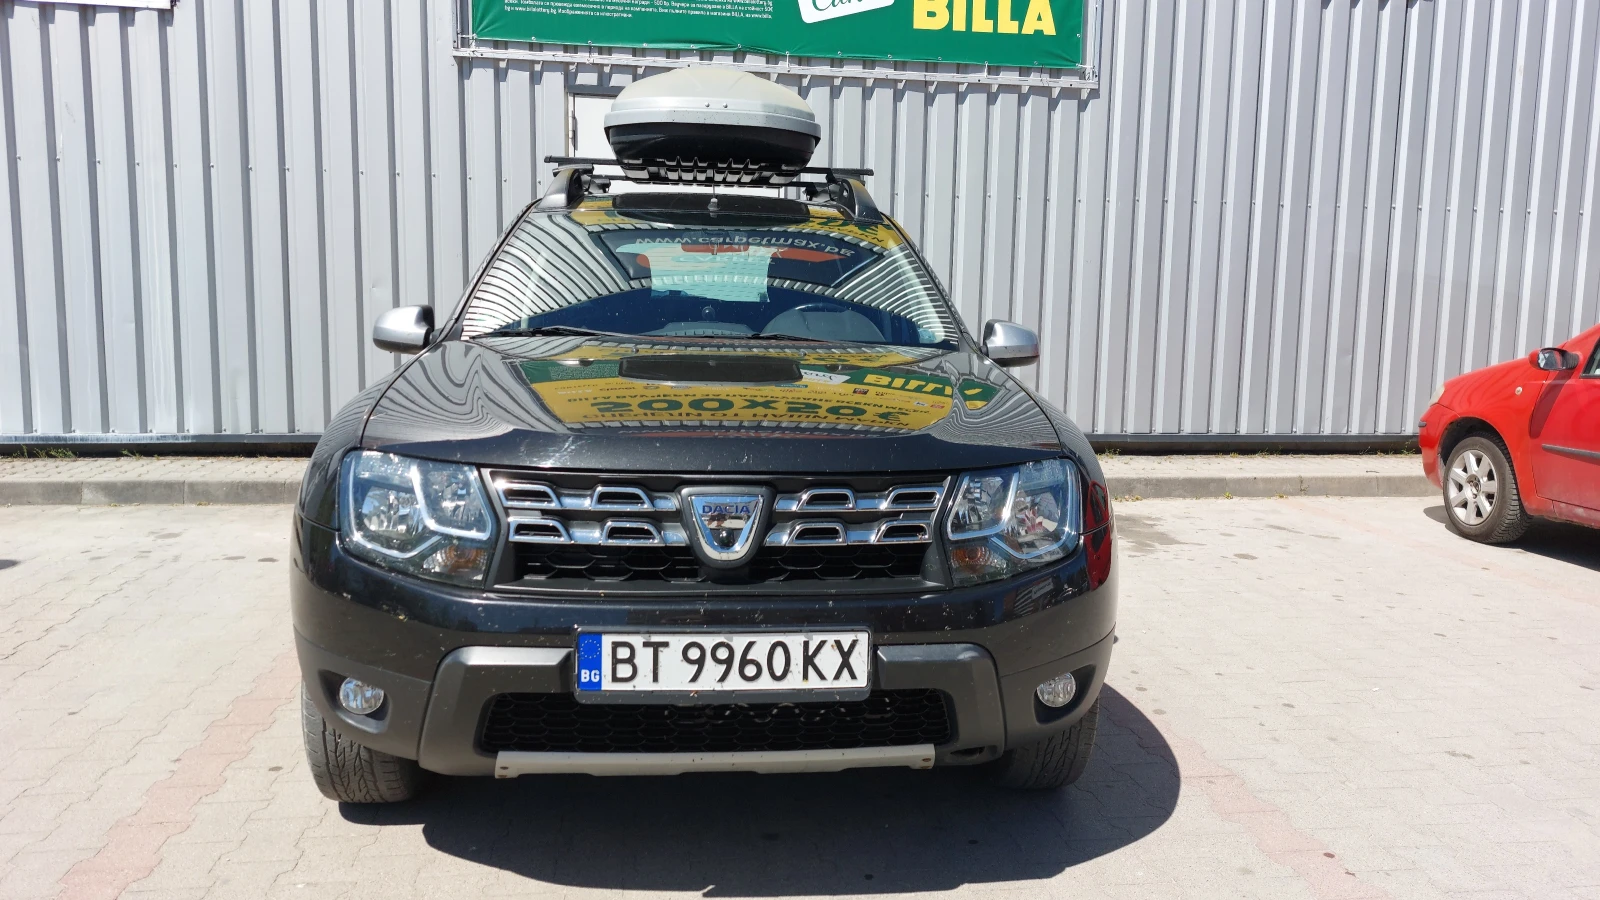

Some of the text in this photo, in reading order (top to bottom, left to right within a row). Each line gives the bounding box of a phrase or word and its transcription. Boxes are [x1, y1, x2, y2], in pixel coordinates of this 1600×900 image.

[913, 0, 1056, 36] BILLA
[702, 505, 751, 514] DACIA
[611, 639, 858, 684] BT 9960 KX
[580, 669, 600, 683] BG
